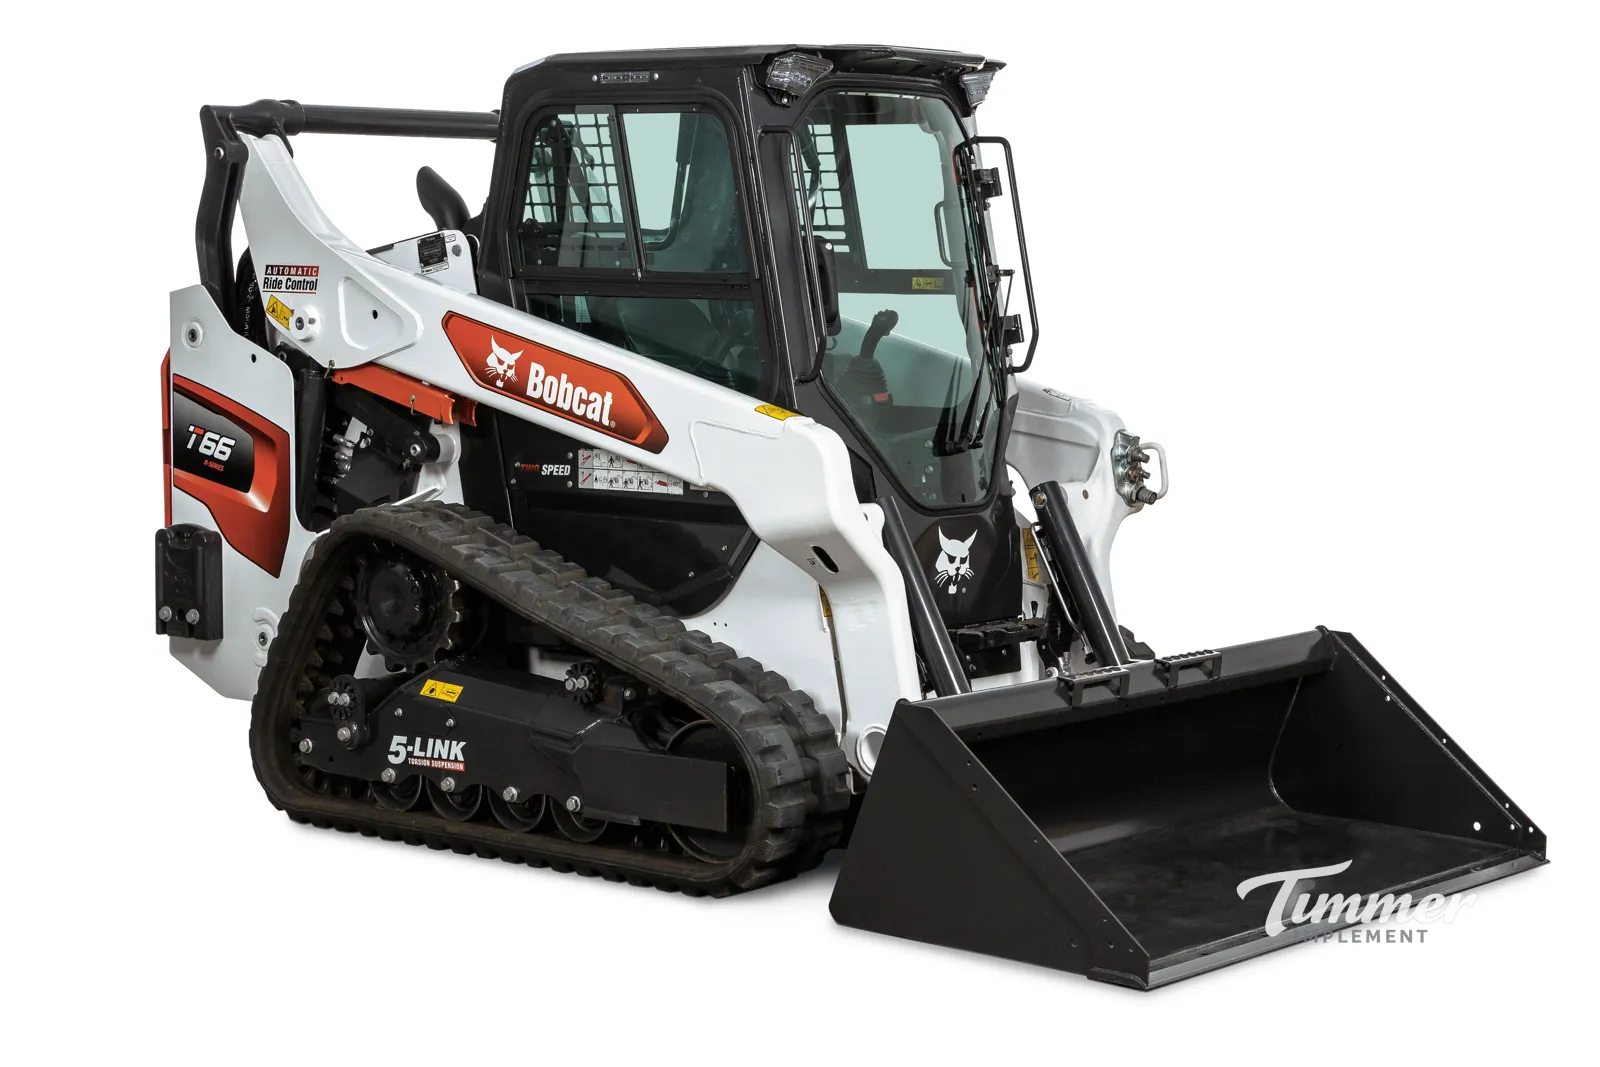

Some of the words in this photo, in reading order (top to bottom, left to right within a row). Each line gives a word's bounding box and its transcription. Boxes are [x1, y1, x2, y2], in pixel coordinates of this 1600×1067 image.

[266, 266, 318, 276] AUTOMATIC
[262, 277, 283, 290] Ride
[285, 277, 318, 291] Control
[526, 361, 613, 426] Bobcat
[186, 425, 236, 462] T66
[520, 463, 540, 473] TWO
[541, 464, 571, 476] SPEED
[387, 735, 467, 765] 5-LINK
[408, 757, 431, 767] TORSION
[431, 760, 464, 770] SUSPENSION
